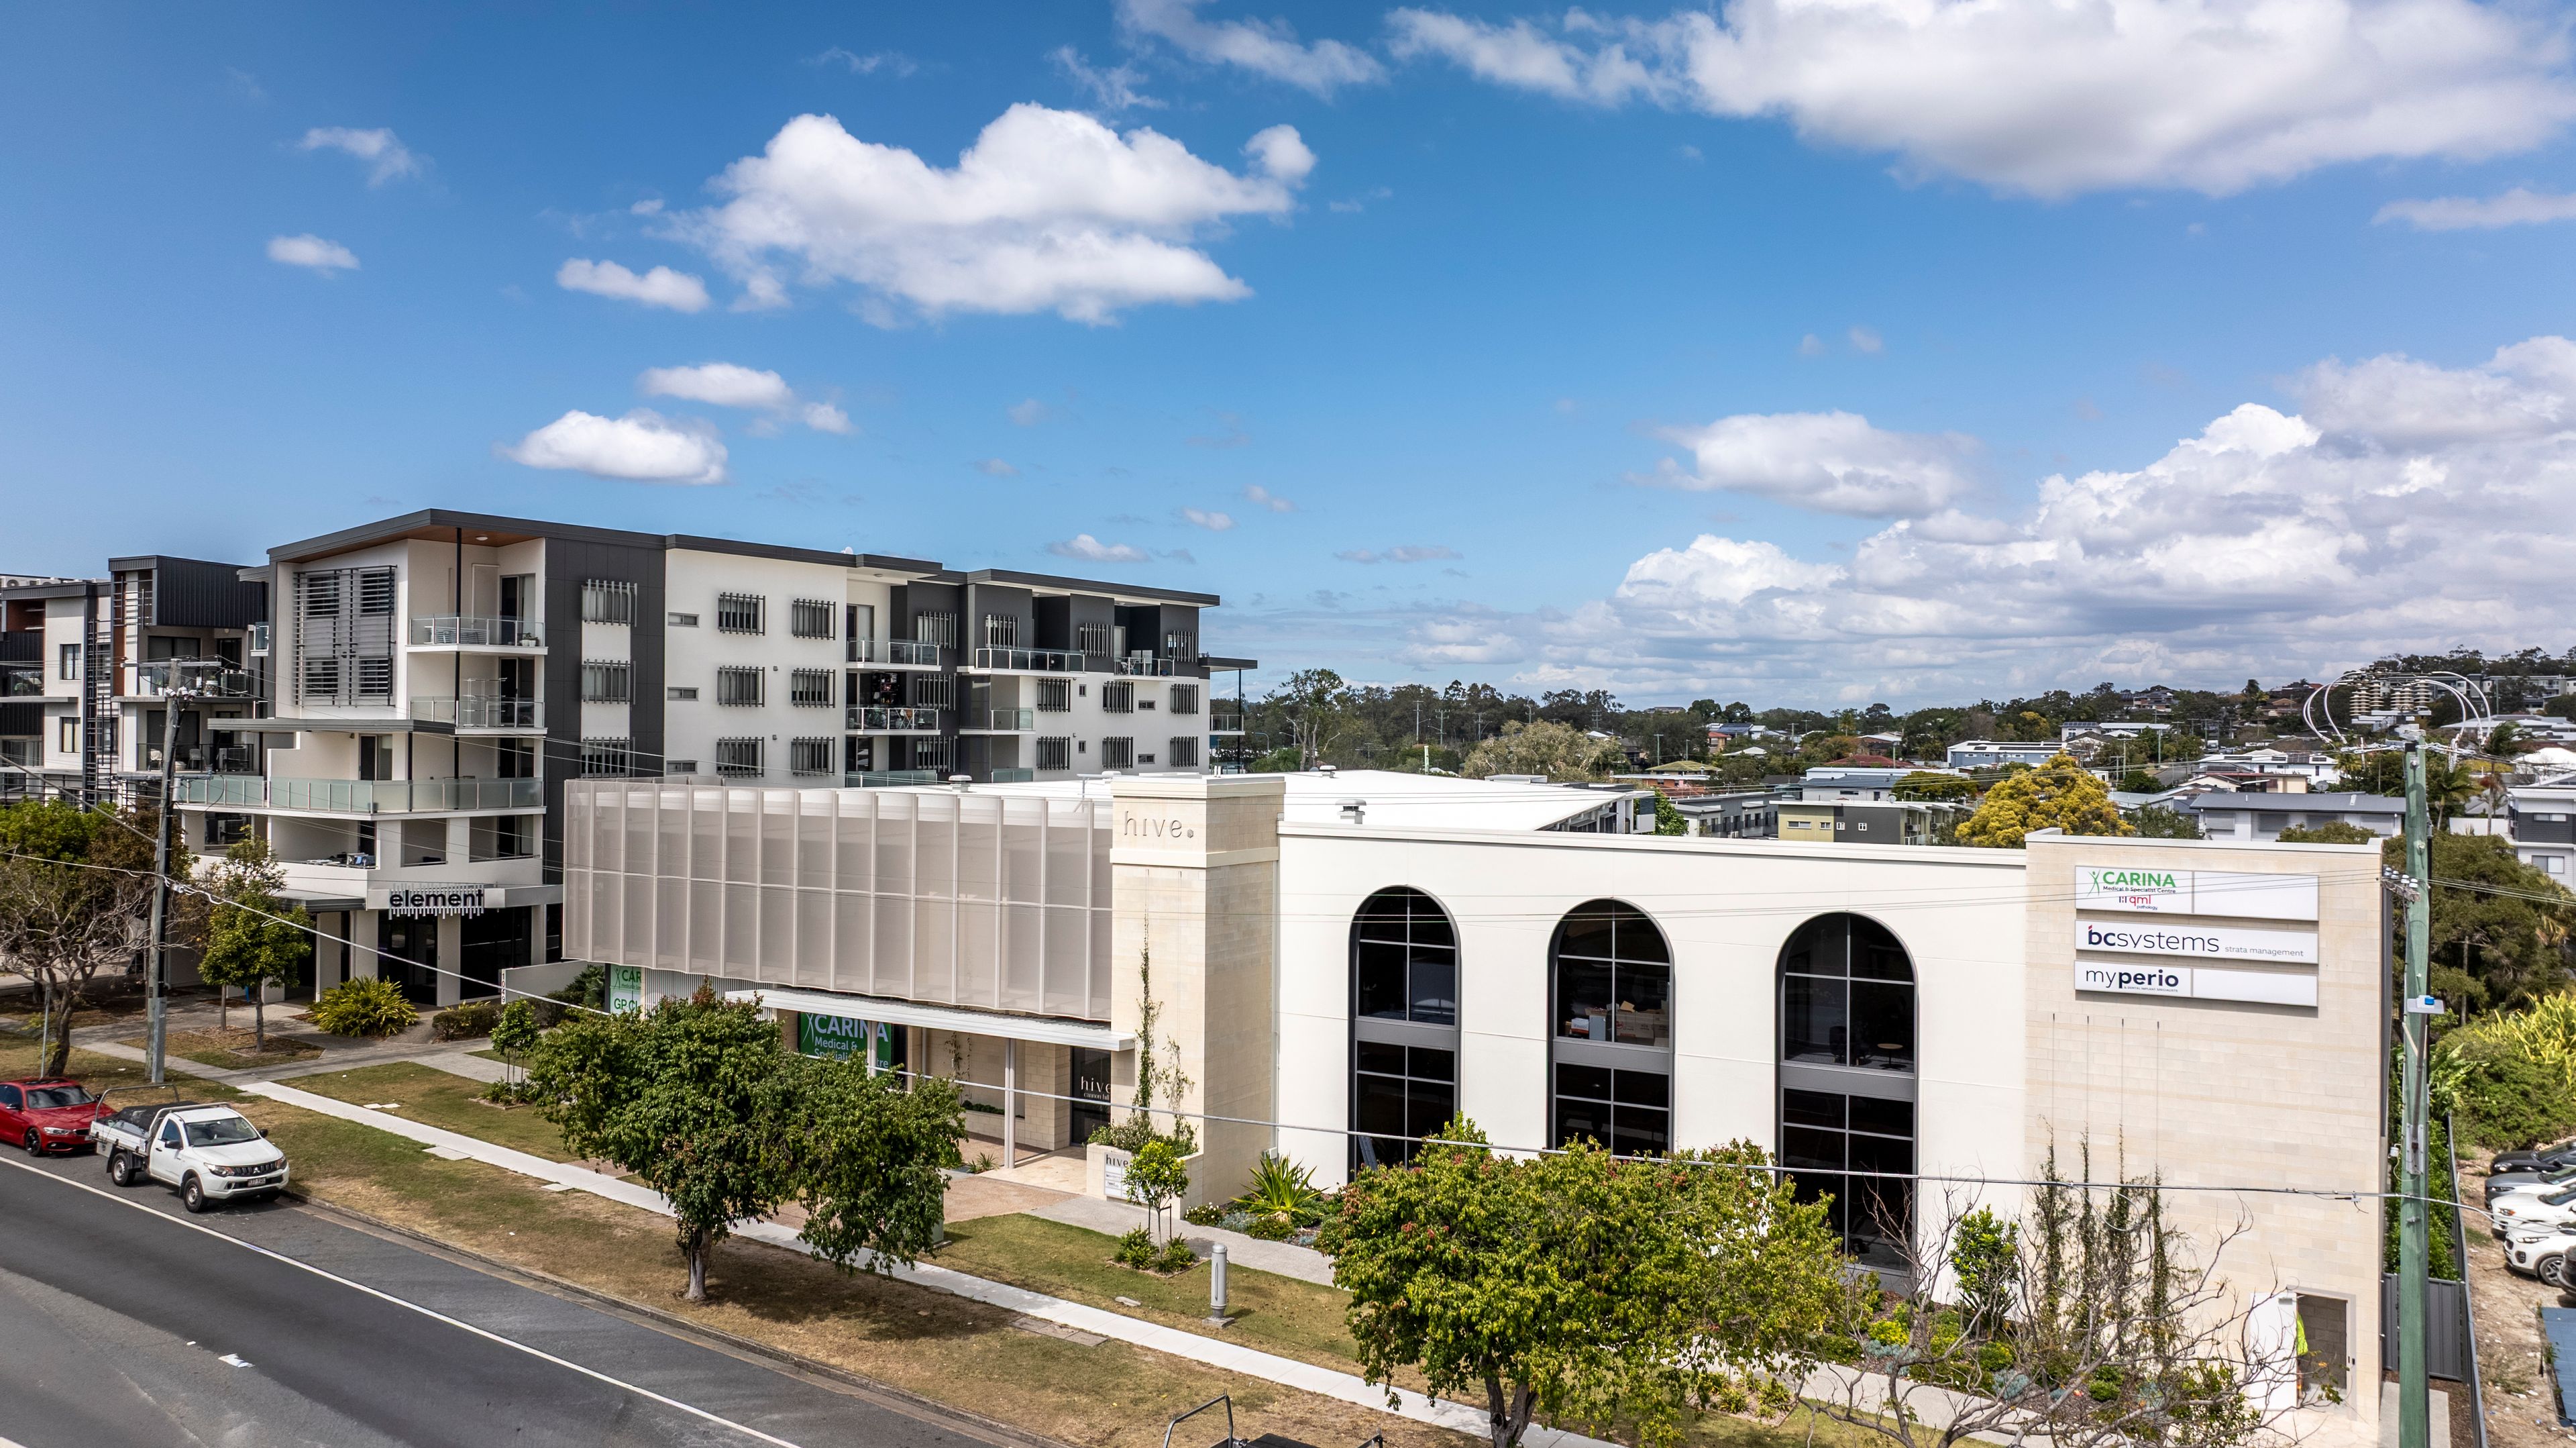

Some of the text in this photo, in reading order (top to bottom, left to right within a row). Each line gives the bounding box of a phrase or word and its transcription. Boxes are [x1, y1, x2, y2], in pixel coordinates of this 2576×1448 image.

[2102, 871, 2176, 887] CARINA
[389, 889, 484, 907] element
[2129, 894, 2151, 907] qml
[2088, 925, 2220, 953] bcsystems
[2249, 947, 2304, 958] management
[622, 970, 641, 983] CAR
[2086, 969, 2180, 989] myperio
[614, 998, 627, 1010] GP
[814, 1036, 857, 1050] Medical &
[1081, 1076, 1111, 1094] hive
